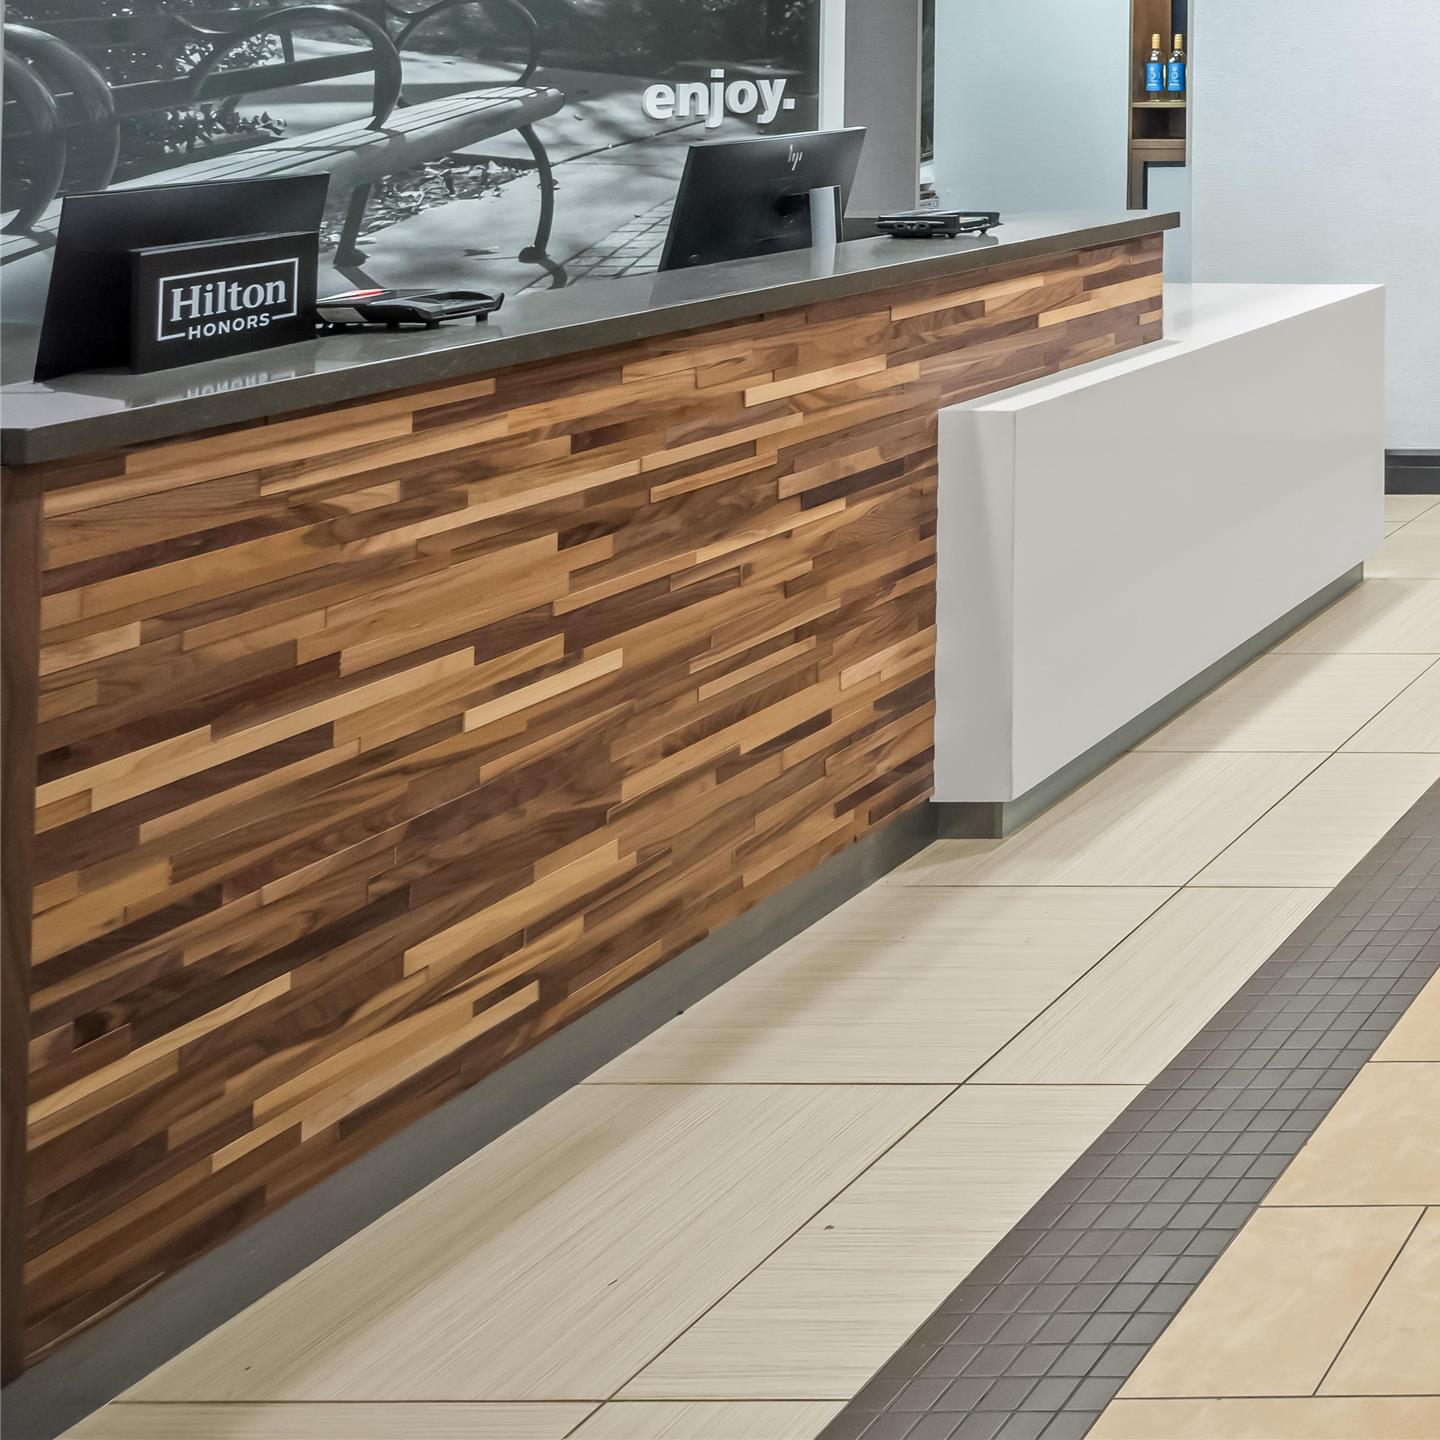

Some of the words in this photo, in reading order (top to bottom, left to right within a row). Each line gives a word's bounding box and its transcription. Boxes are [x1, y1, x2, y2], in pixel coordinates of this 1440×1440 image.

[642, 69, 795, 128] enjoy.
[170, 279, 287, 322] Hilton
[188, 313, 270, 340] HONORS
